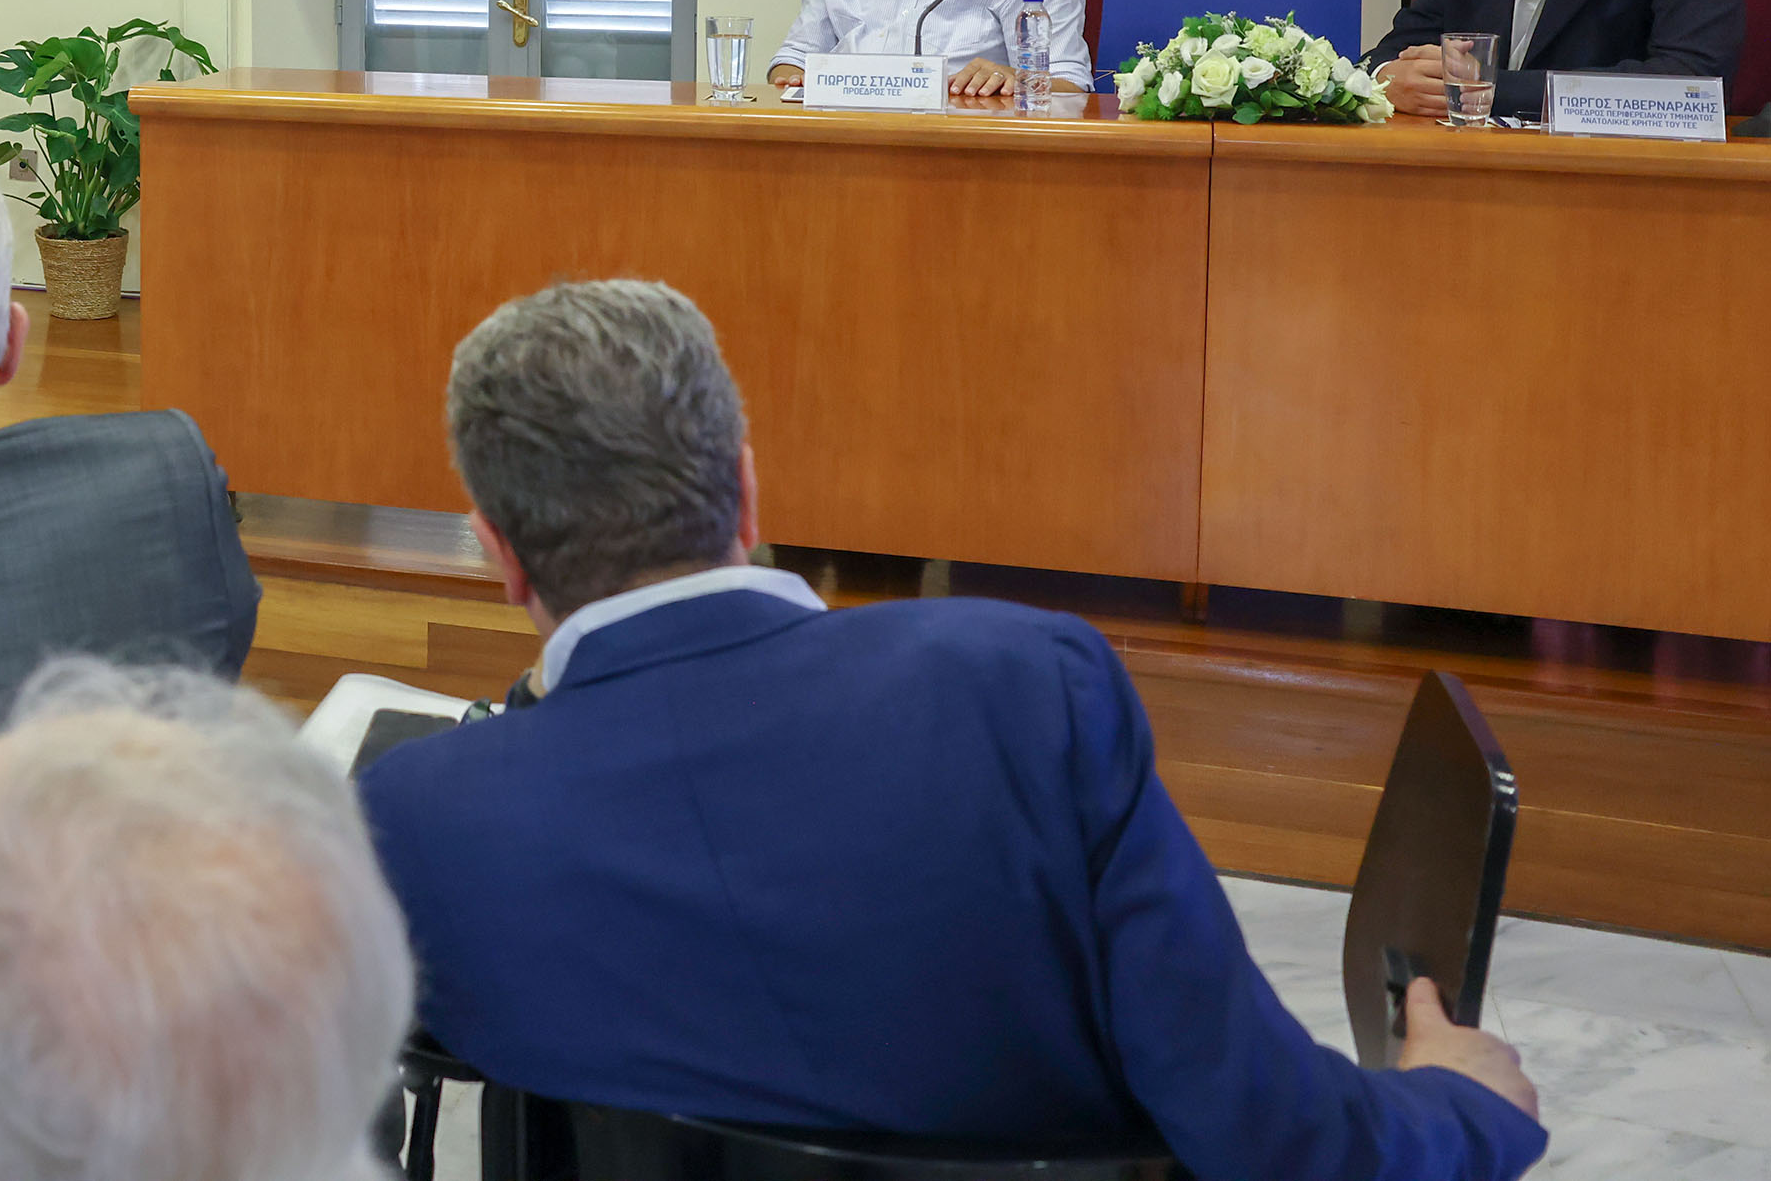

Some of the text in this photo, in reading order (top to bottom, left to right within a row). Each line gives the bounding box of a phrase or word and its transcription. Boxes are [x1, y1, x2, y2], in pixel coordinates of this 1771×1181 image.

[817, 75, 929, 88] ΓΙΩΡΓΟΣ ΣΤΑΣΙΝΟΣ
[843, 87, 884, 96] ΠΡΟΕΔΡΟΣ
[1560, 97, 1718, 113] ΓΙΩΡΓΟΣ ΤΑΒΕΡΝΑΡΑΚΗΣ
[1670, 113, 1713, 121] ΤΜΗΜΑΤΟΣ
[1581, 118, 1629, 126] ΑΝΑΤΟΛΙΚΗΣ
